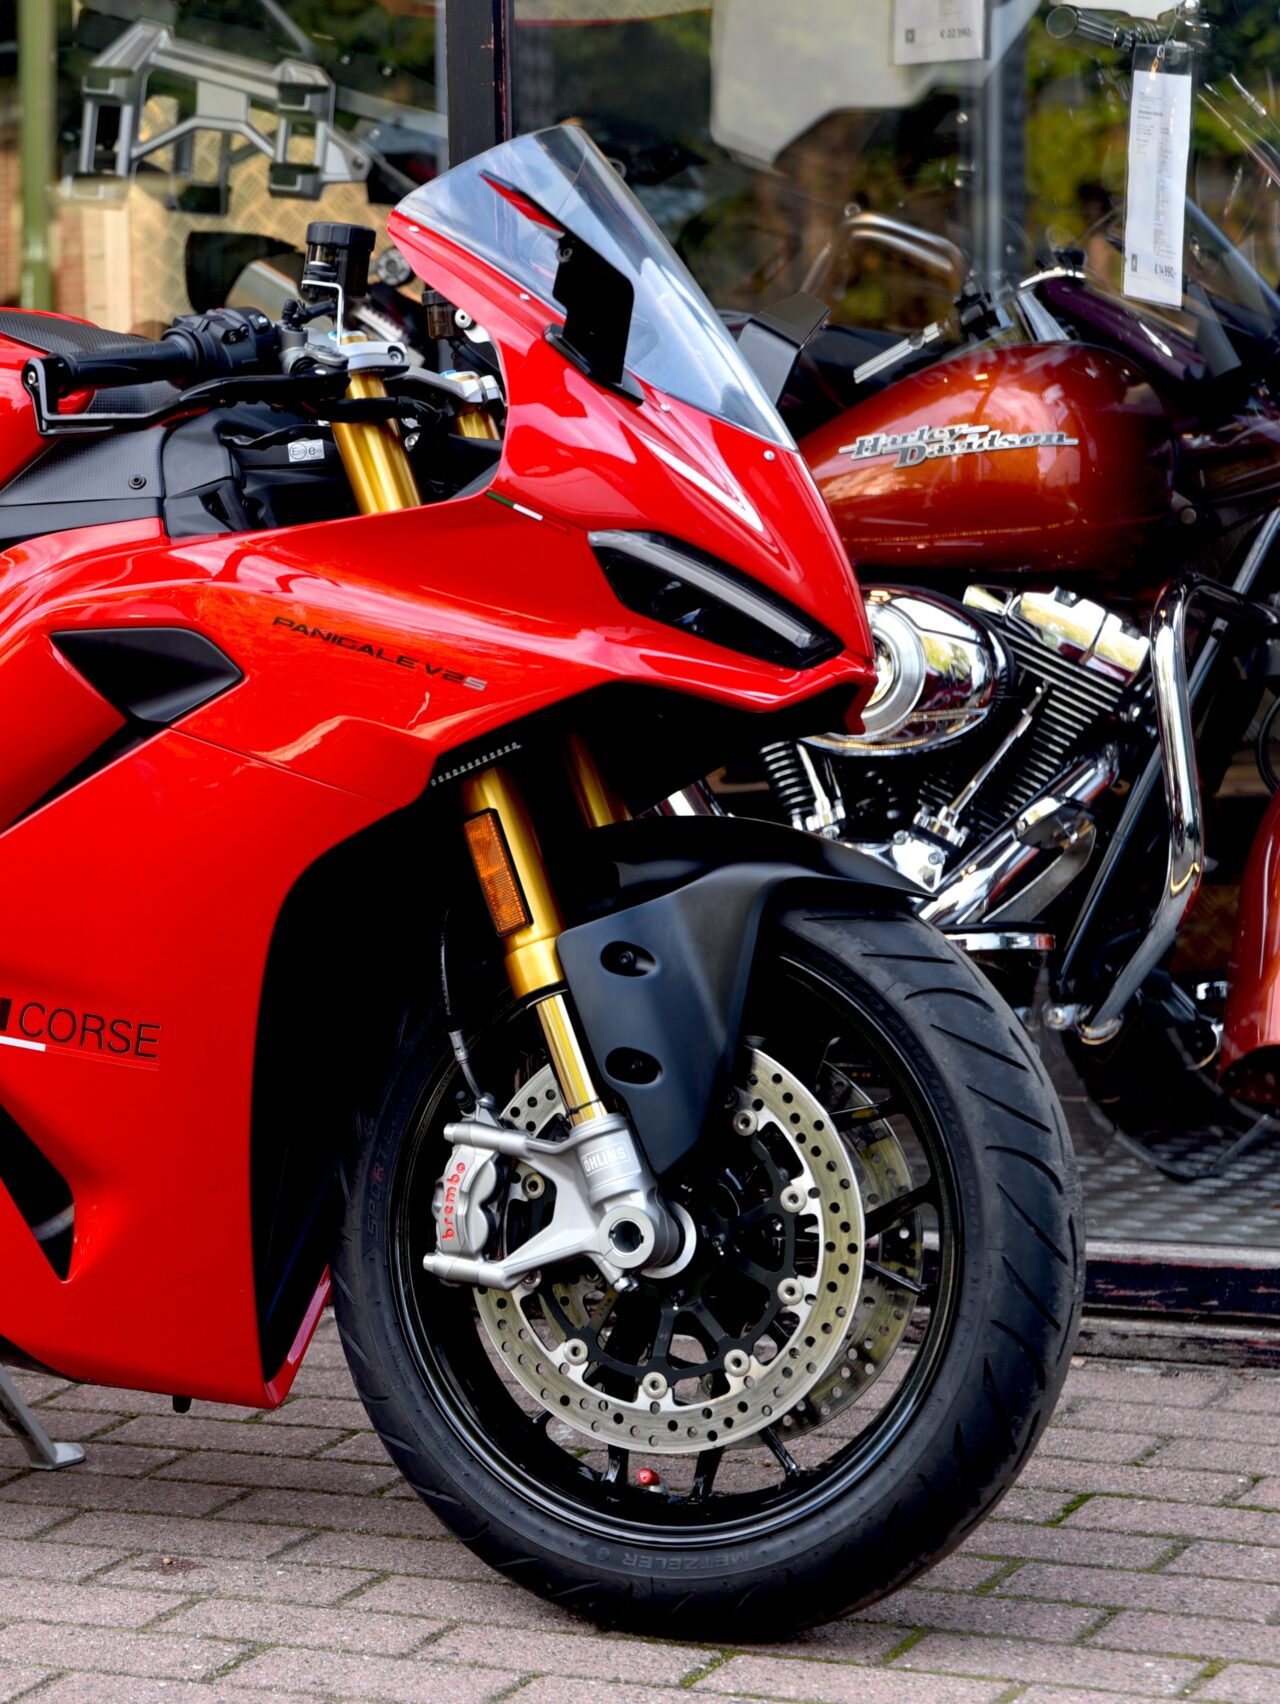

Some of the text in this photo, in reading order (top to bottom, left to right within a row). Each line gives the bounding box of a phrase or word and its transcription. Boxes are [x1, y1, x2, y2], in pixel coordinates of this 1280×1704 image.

[272, 616, 419, 670] PANIGALE
[19, 1003, 162, 1059] CORSE
[442, 1162, 466, 1240] brembo
[621, 1551, 754, 1570] METZELER
